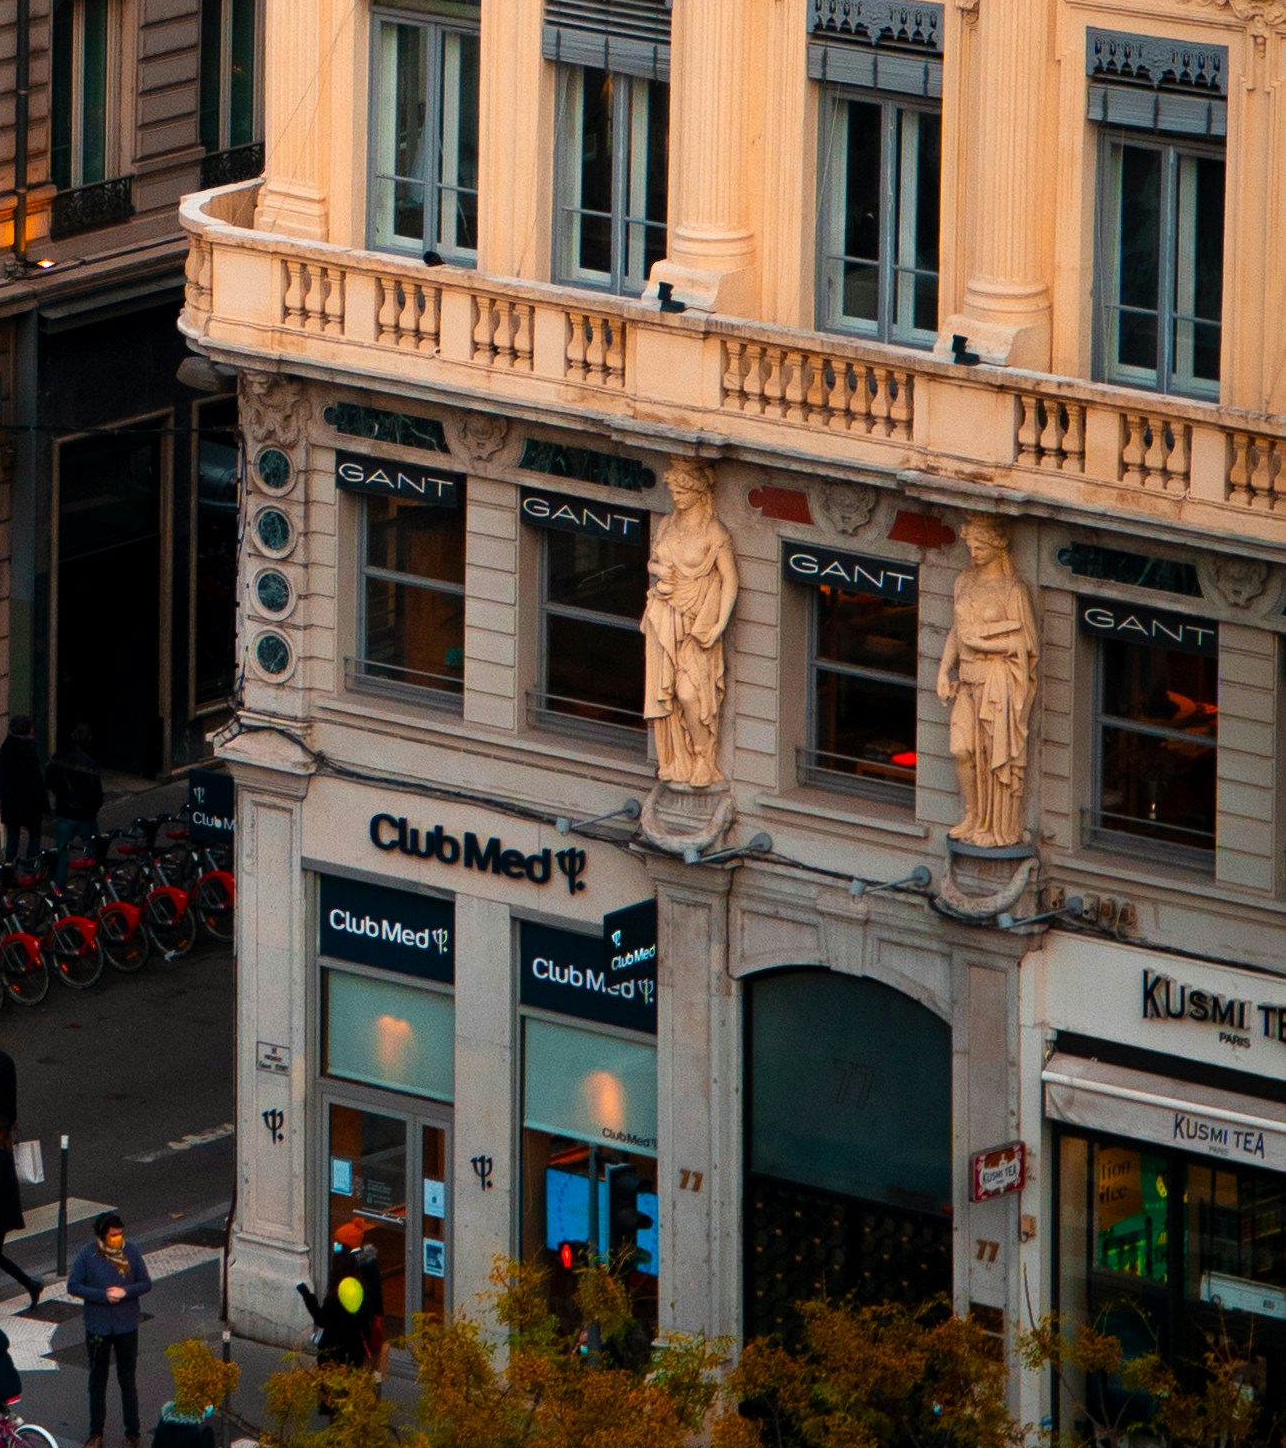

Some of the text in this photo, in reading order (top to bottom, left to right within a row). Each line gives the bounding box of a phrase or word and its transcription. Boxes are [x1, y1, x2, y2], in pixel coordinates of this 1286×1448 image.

[338, 462, 454, 497] GANT
[522, 497, 641, 536] GANT
[789, 553, 915, 593] GANT
[1084, 608, 1216, 647] GANT
[368, 812, 552, 884] Club Med
[329, 907, 430, 950] Club Med
[531, 956, 583, 987] Club
[611, 943, 656, 971] Club Med
[1141, 968, 1251, 1031] KUSMI
[1219, 1032, 1251, 1049] PARIS
[1174, 1112, 1265, 1159] KUSMI TEA
